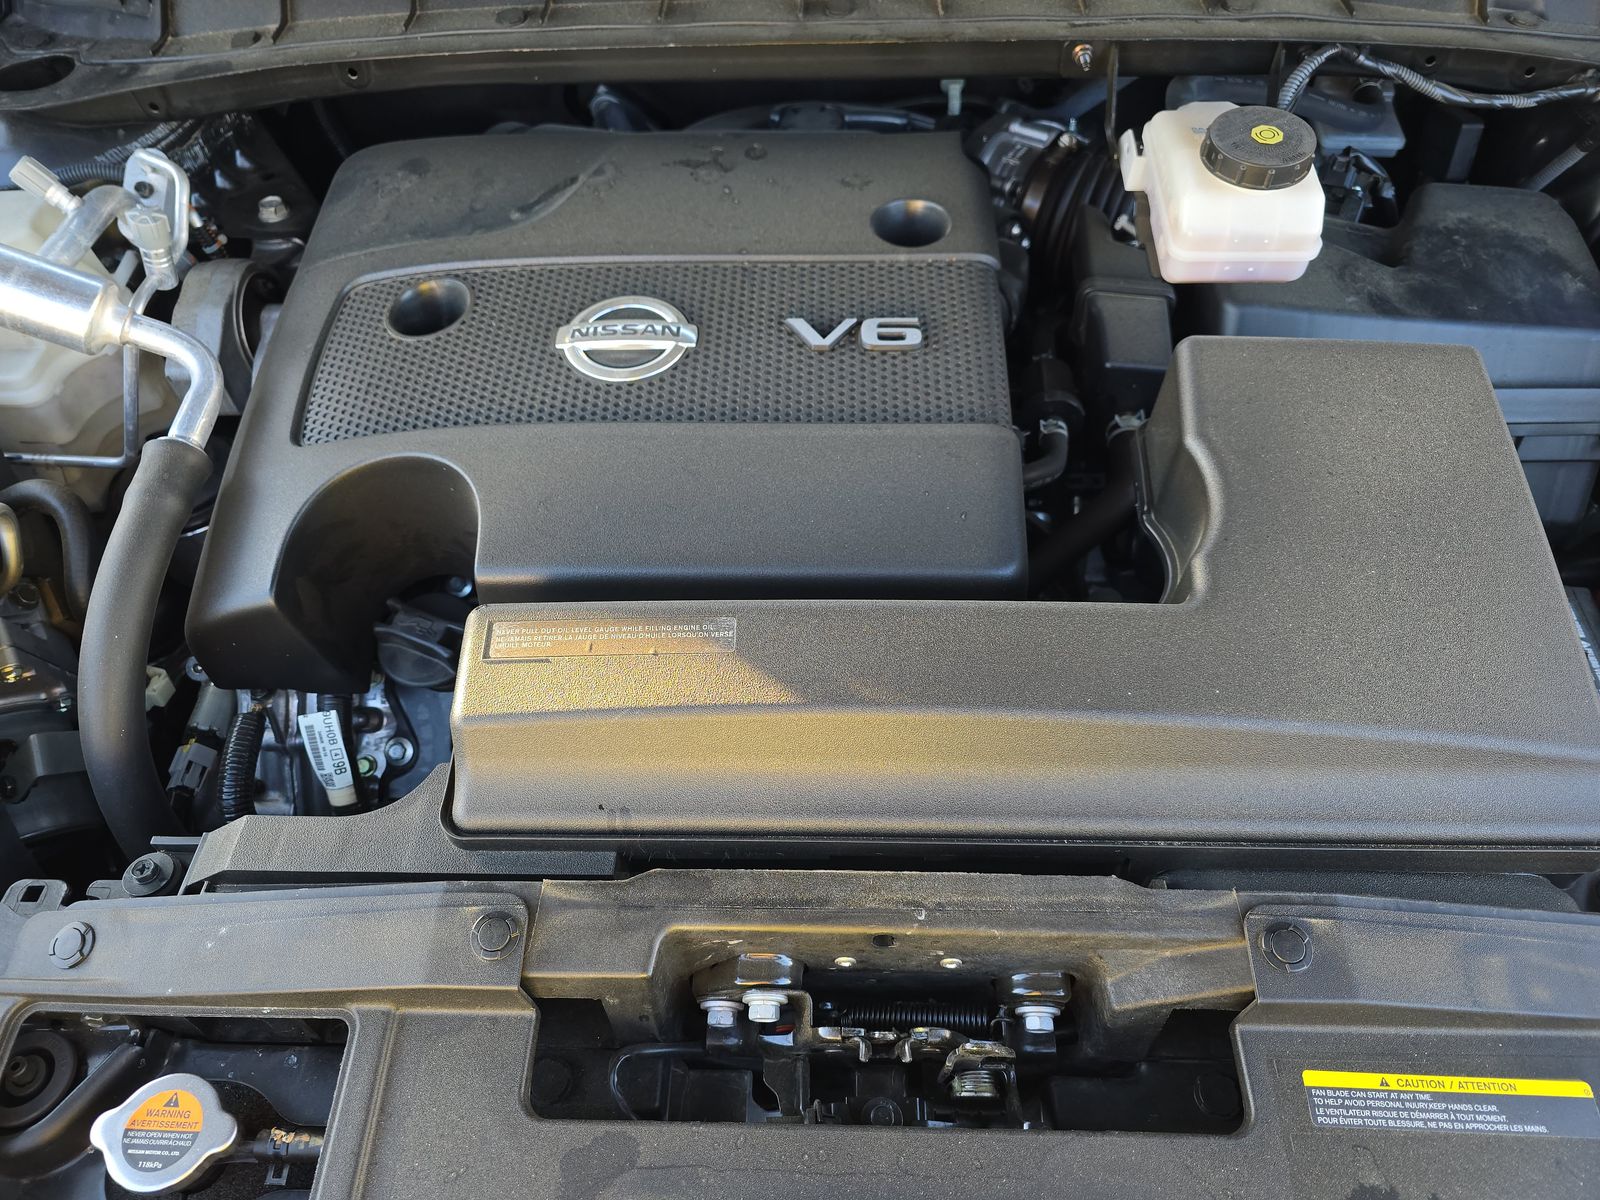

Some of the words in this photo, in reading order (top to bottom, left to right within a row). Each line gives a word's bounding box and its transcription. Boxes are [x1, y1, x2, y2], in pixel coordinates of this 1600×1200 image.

[570, 323, 681, 338] NISSAN
[785, 317, 923, 350] V6
[496, 627, 519, 635] NEVER
[571, 626, 593, 634] LEVEL
[594, 625, 619, 633] GAUGE
[1396, 1078, 1446, 1089] CAUTION
[1449, 1079, 1454, 1089] /
[1458, 1080, 1517, 1092] ATTENTION
[1326, 1089, 1350, 1097] BLADE
[1350, 1090, 1366, 1098] CAN
[1367, 1091, 1389, 1099] START
[1400, 1092, 1414, 1100] ANY
[1414, 1093, 1433, 1101] TIME.
[1325, 1098, 1343, 1106] HELP
[1344, 1099, 1366, 1107] AVOID
[1367, 1100, 1404, 1108] PERSONAL
[1448, 1103, 1473, 1111] HANDS
[1474, 1104, 1499, 1112] CLEAR.
[146, 1108, 191, 1119] WARNING
[1324, 1108, 1371, 1117] VENTILATEUR
[1372, 1110, 1398, 1118] RISQUE
[1410, 1109, 1449, 1120] DÉMARRER
[1450, 1111, 1457, 1120] À
[1456, 1113, 1474, 1121] TOUT
[1476, 1114, 1509, 1123] MOMENT.
[130, 1119, 199, 1129] AVERTISSEMENT
[1318, 1116, 1338, 1125] POUR
[1340, 1115, 1362, 1125] ÉVITER
[1364, 1118, 1388, 1126] TOUTE
[1428, 1121, 1438, 1129] NE
[1465, 1123, 1510, 1132] APPROCHER
[1524, 1125, 1550, 1134] MAINS.
